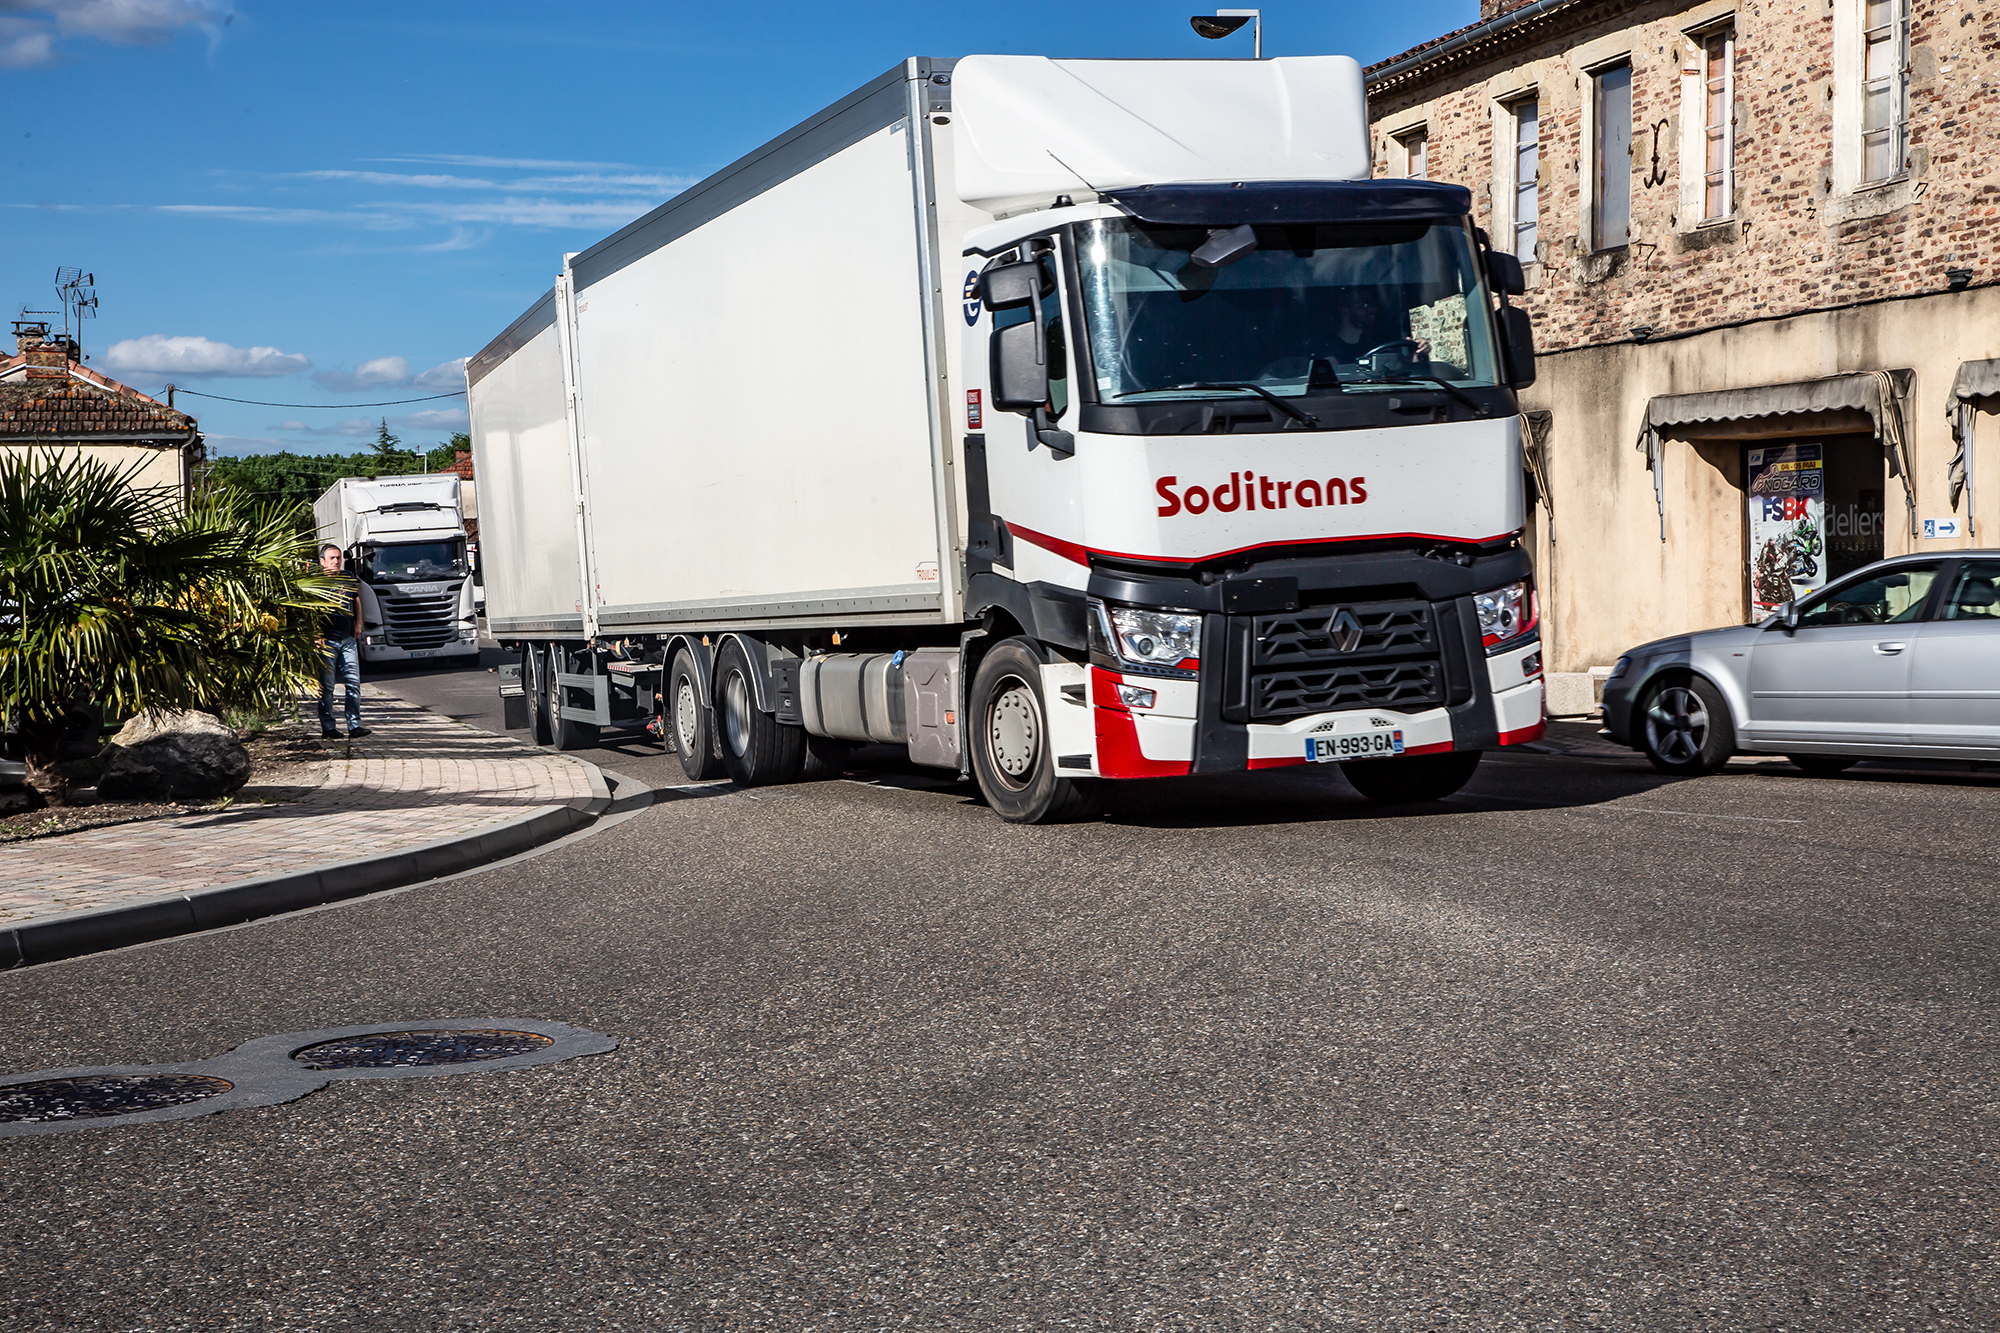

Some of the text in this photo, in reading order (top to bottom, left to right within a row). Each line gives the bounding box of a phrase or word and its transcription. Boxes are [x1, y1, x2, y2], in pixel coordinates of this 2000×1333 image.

[1155, 470, 1368, 517] Soditrans
[1762, 475, 1821, 493] NOGARO
[1762, 496, 1810, 522] FSBK
[398, 585, 439, 594] SCANIA
[1315, 734, 1393, 757] EN-993-GA
